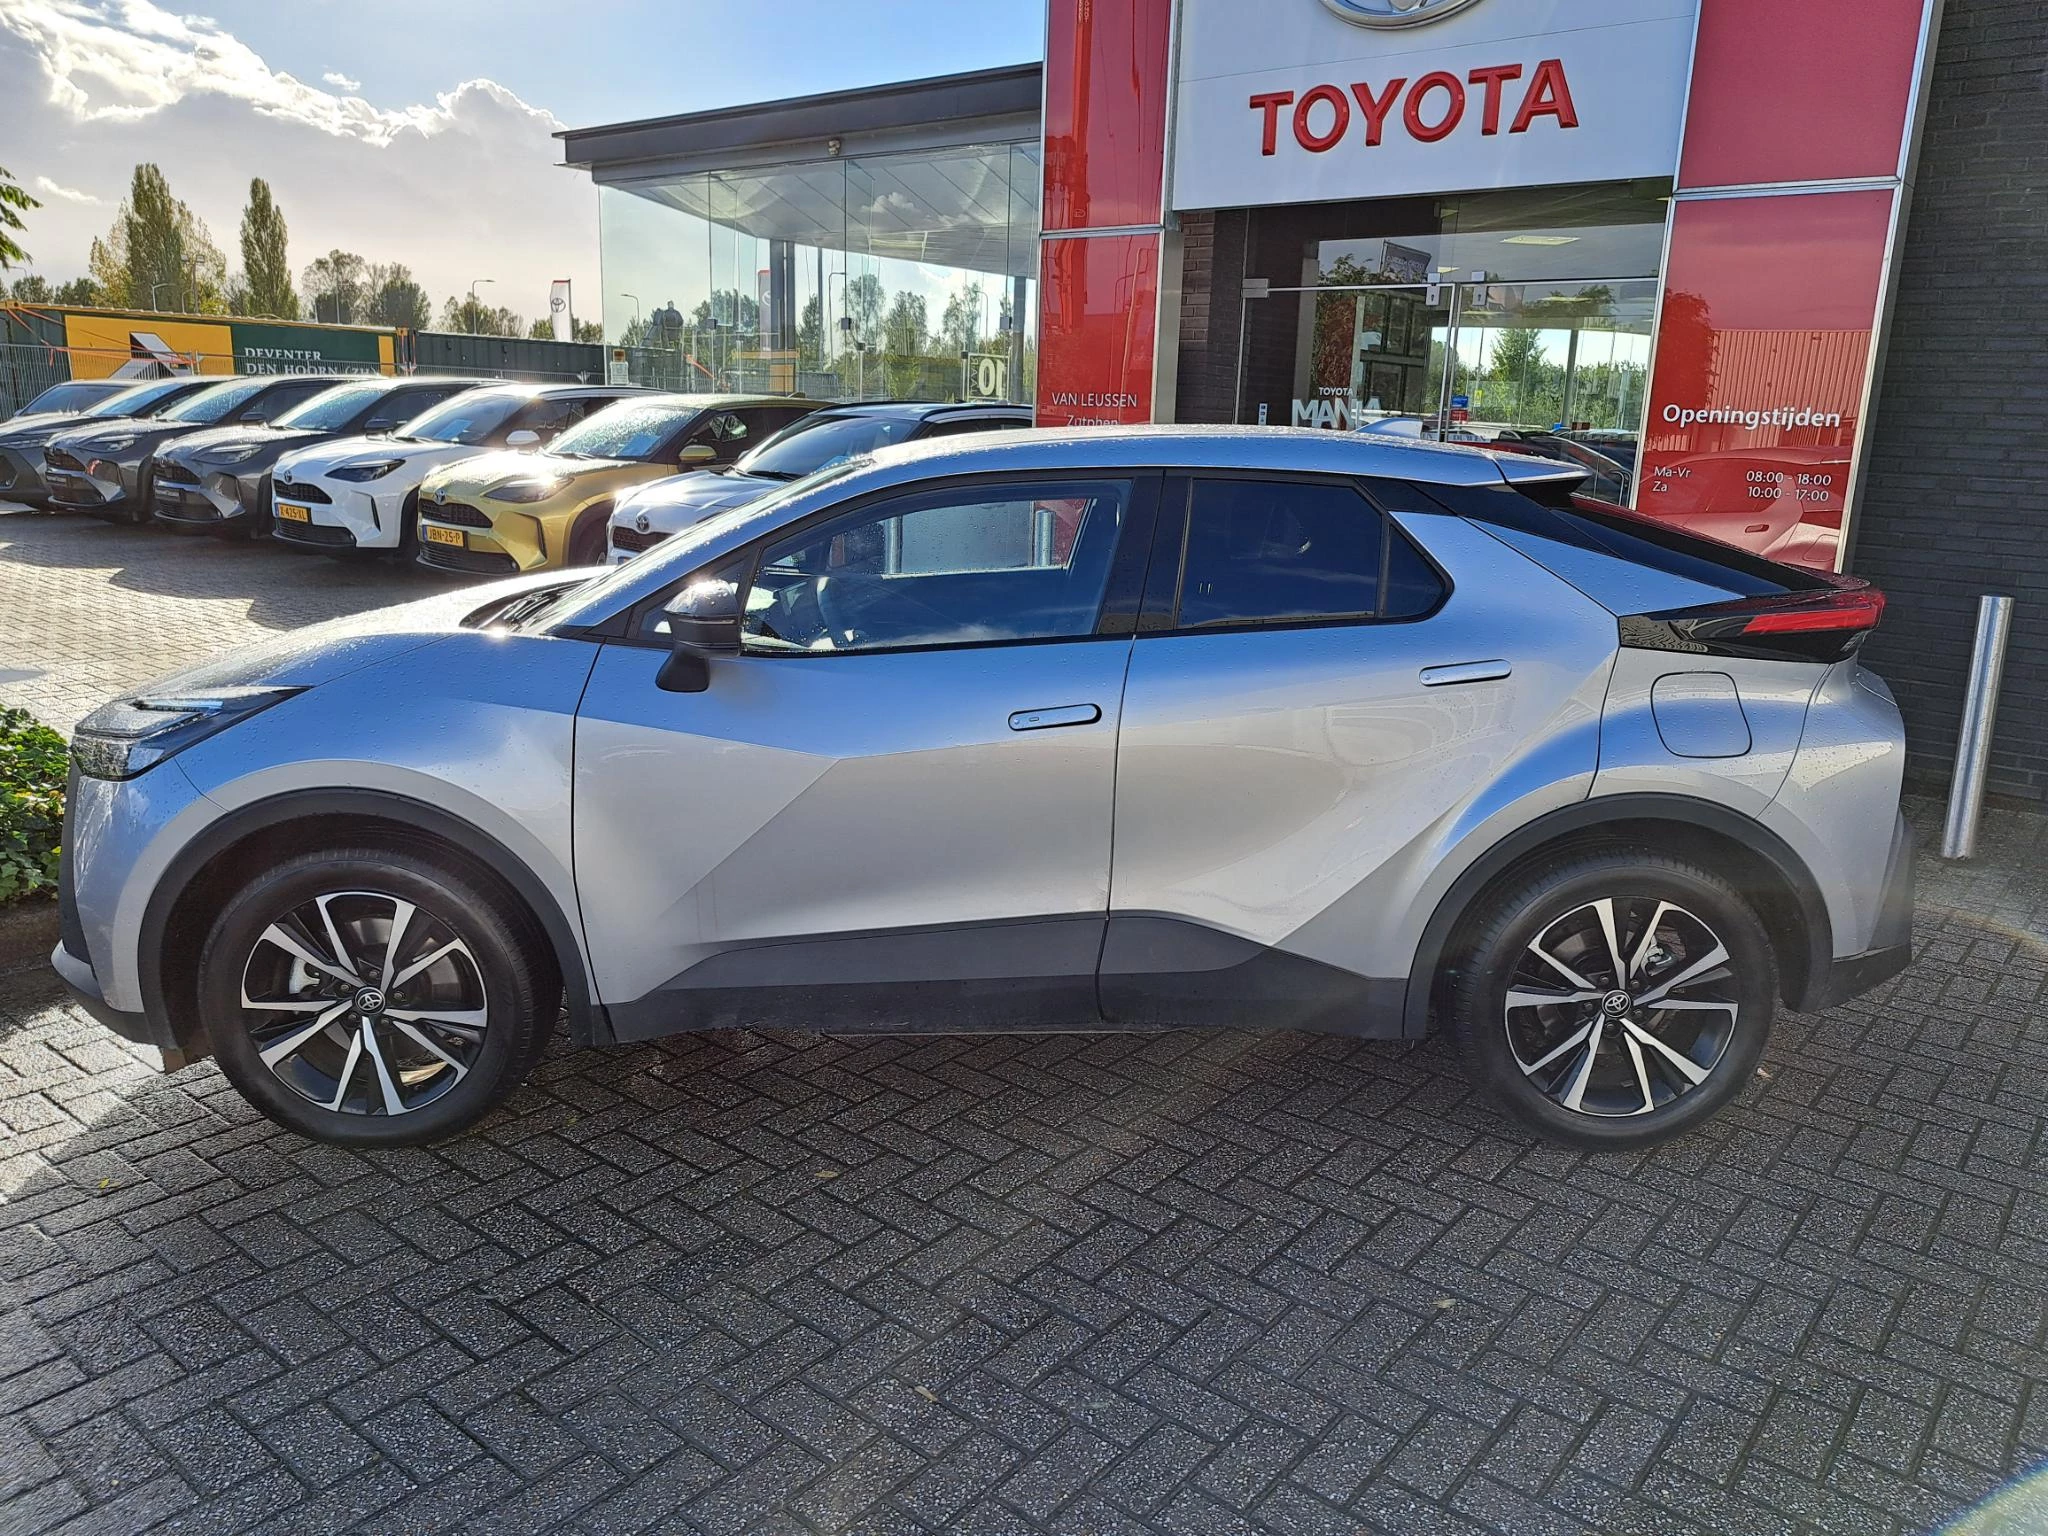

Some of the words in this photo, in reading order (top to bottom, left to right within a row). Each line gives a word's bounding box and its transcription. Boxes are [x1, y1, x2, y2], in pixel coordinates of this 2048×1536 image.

[1249, 58, 1579, 156] TOYOTA
[244, 347, 321, 360] DEVENTER
[246, 362, 277, 375] DEN
[284, 364, 338, 375] HOORN
[1052, 392, 1077, 406] VAN
[1081, 393, 1137, 408] LEUSSEN
[1319, 386, 1354, 396] TOYOTA
[1662, 403, 1842, 431] Openingstijden
[1653, 465, 1692, 479] Ma-Vr
[1746, 470, 1784, 484] 08:00
[1797, 472, 1832, 486] 18:00
[1652, 480, 1668, 493] Za
[1748, 486, 1782, 499] 10:00
[1795, 488, 1829, 502] 17:00
